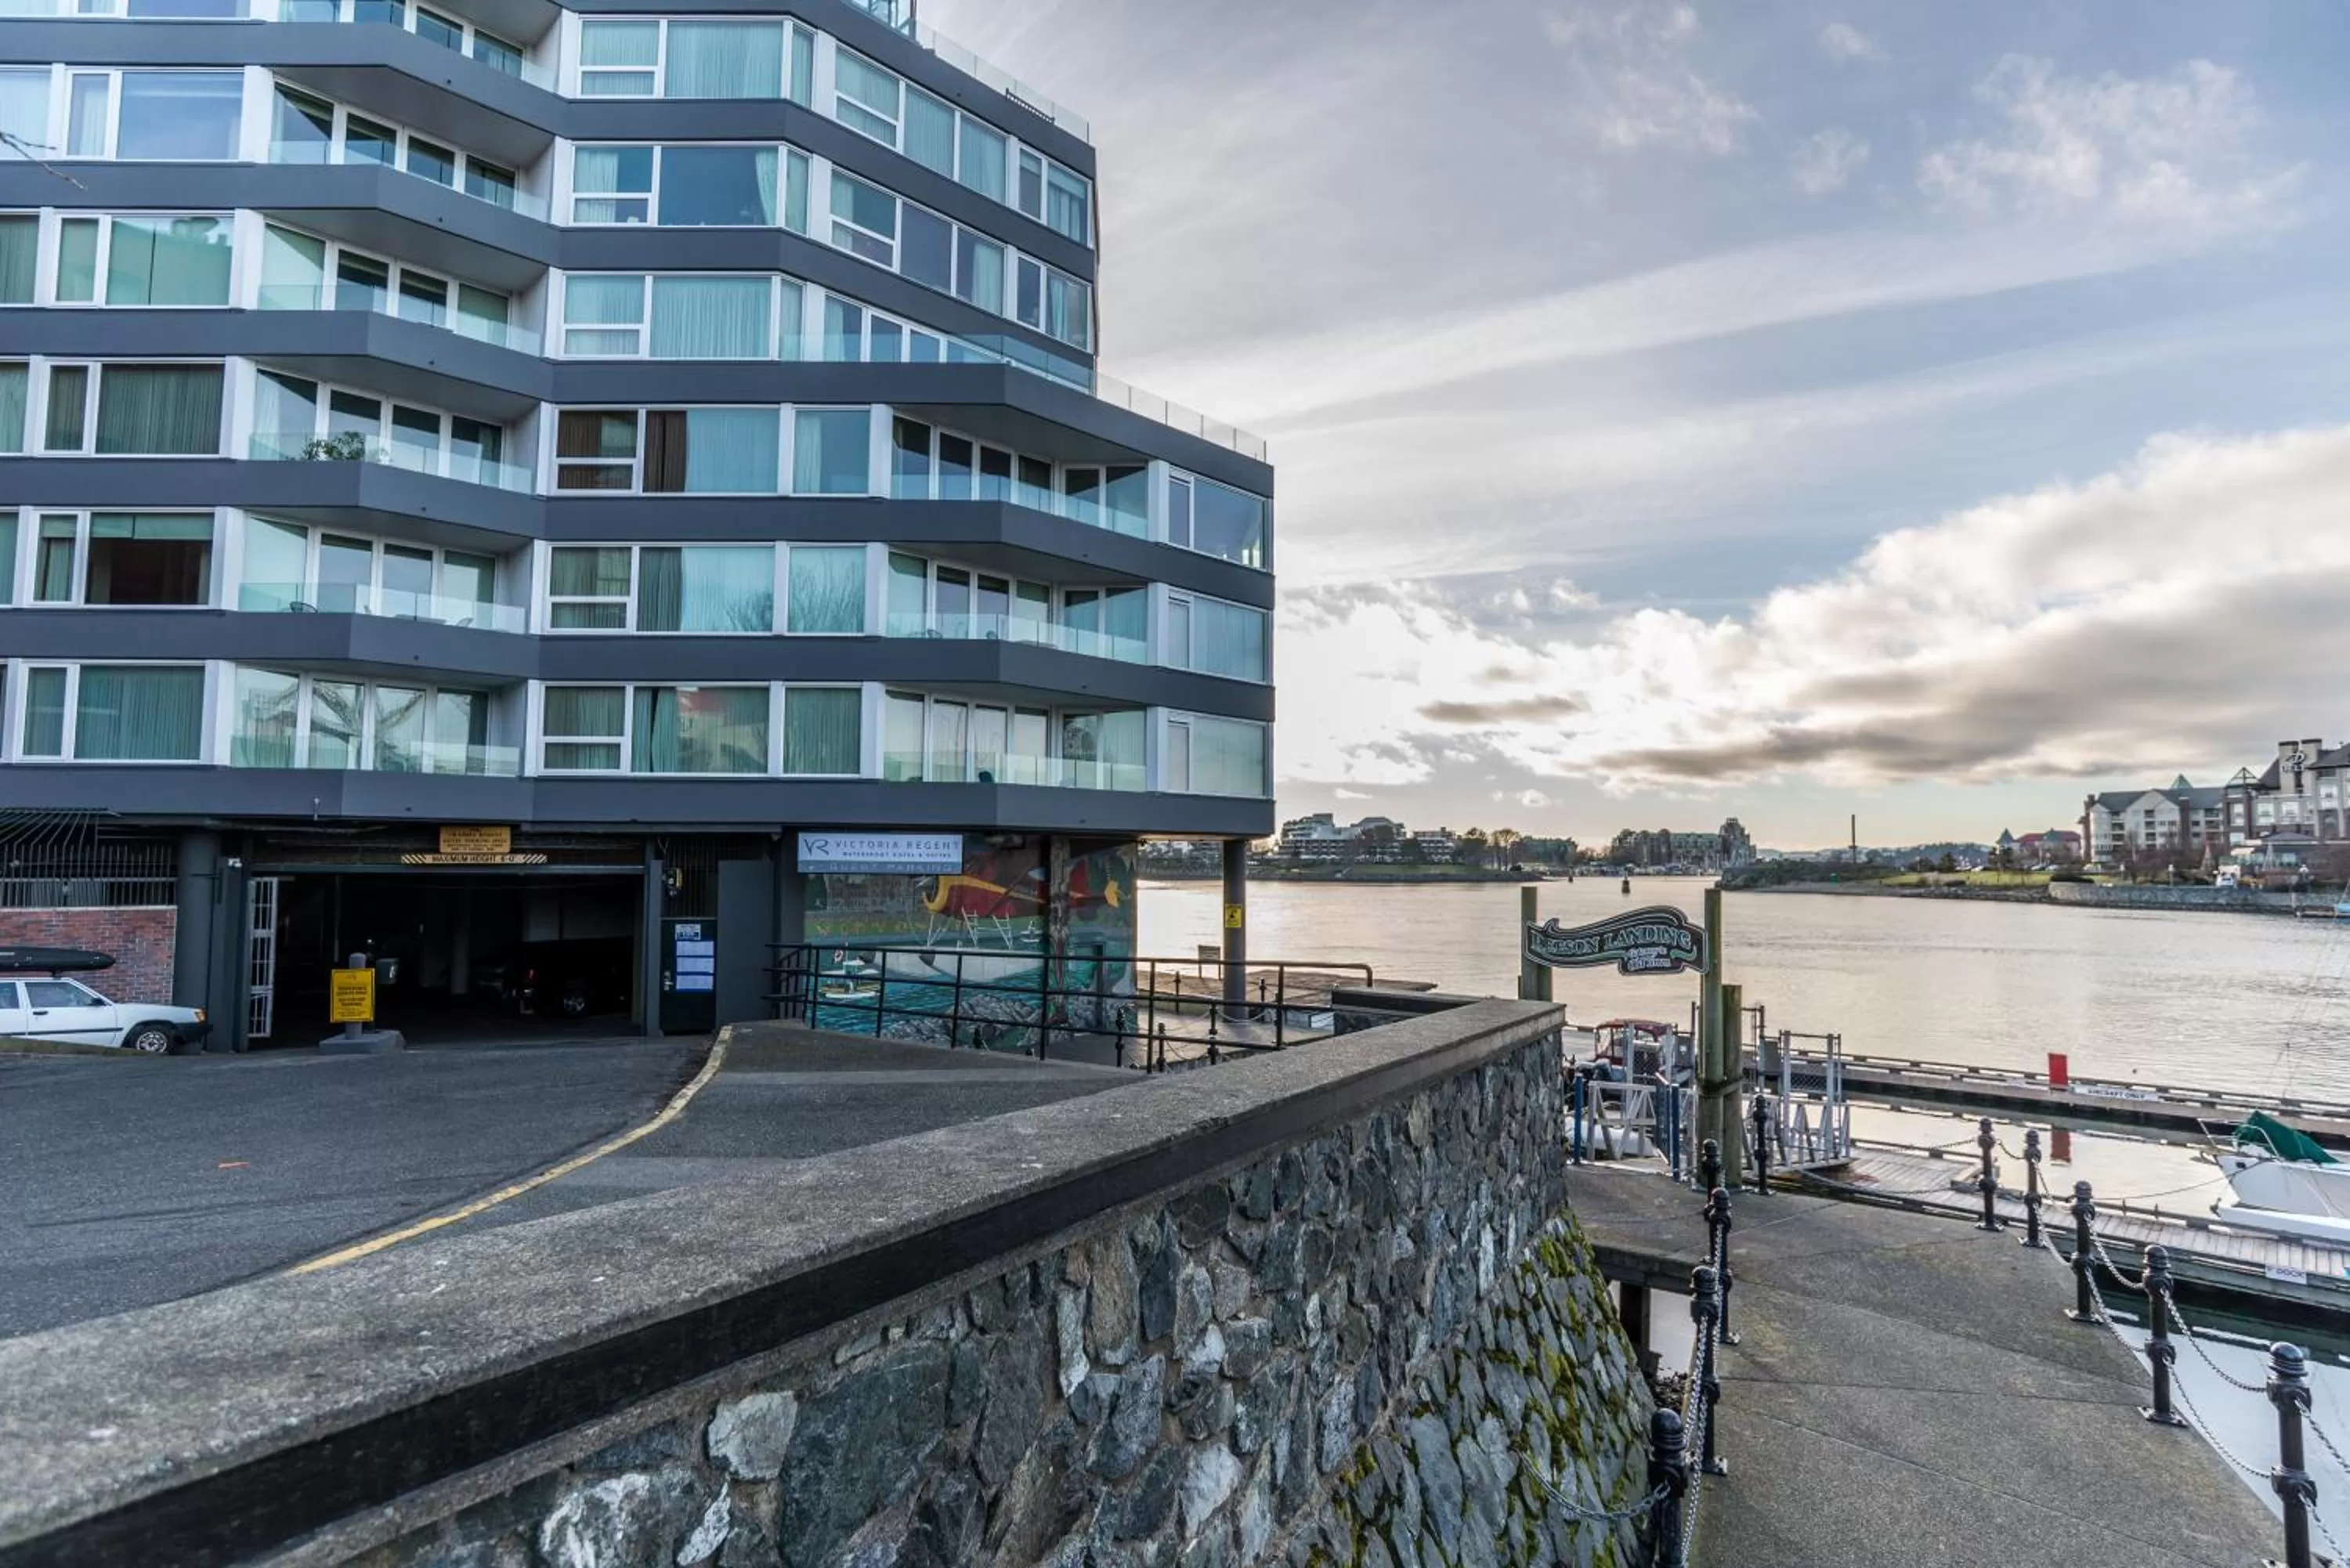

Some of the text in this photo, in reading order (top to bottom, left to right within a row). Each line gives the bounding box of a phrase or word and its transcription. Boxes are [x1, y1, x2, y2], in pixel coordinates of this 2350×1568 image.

[835, 840, 960, 851] VICTORIA REGENT
[1603, 926, 1691, 950] LANDING
[2087, 1088, 2124, 1097] AIRCRAFT
